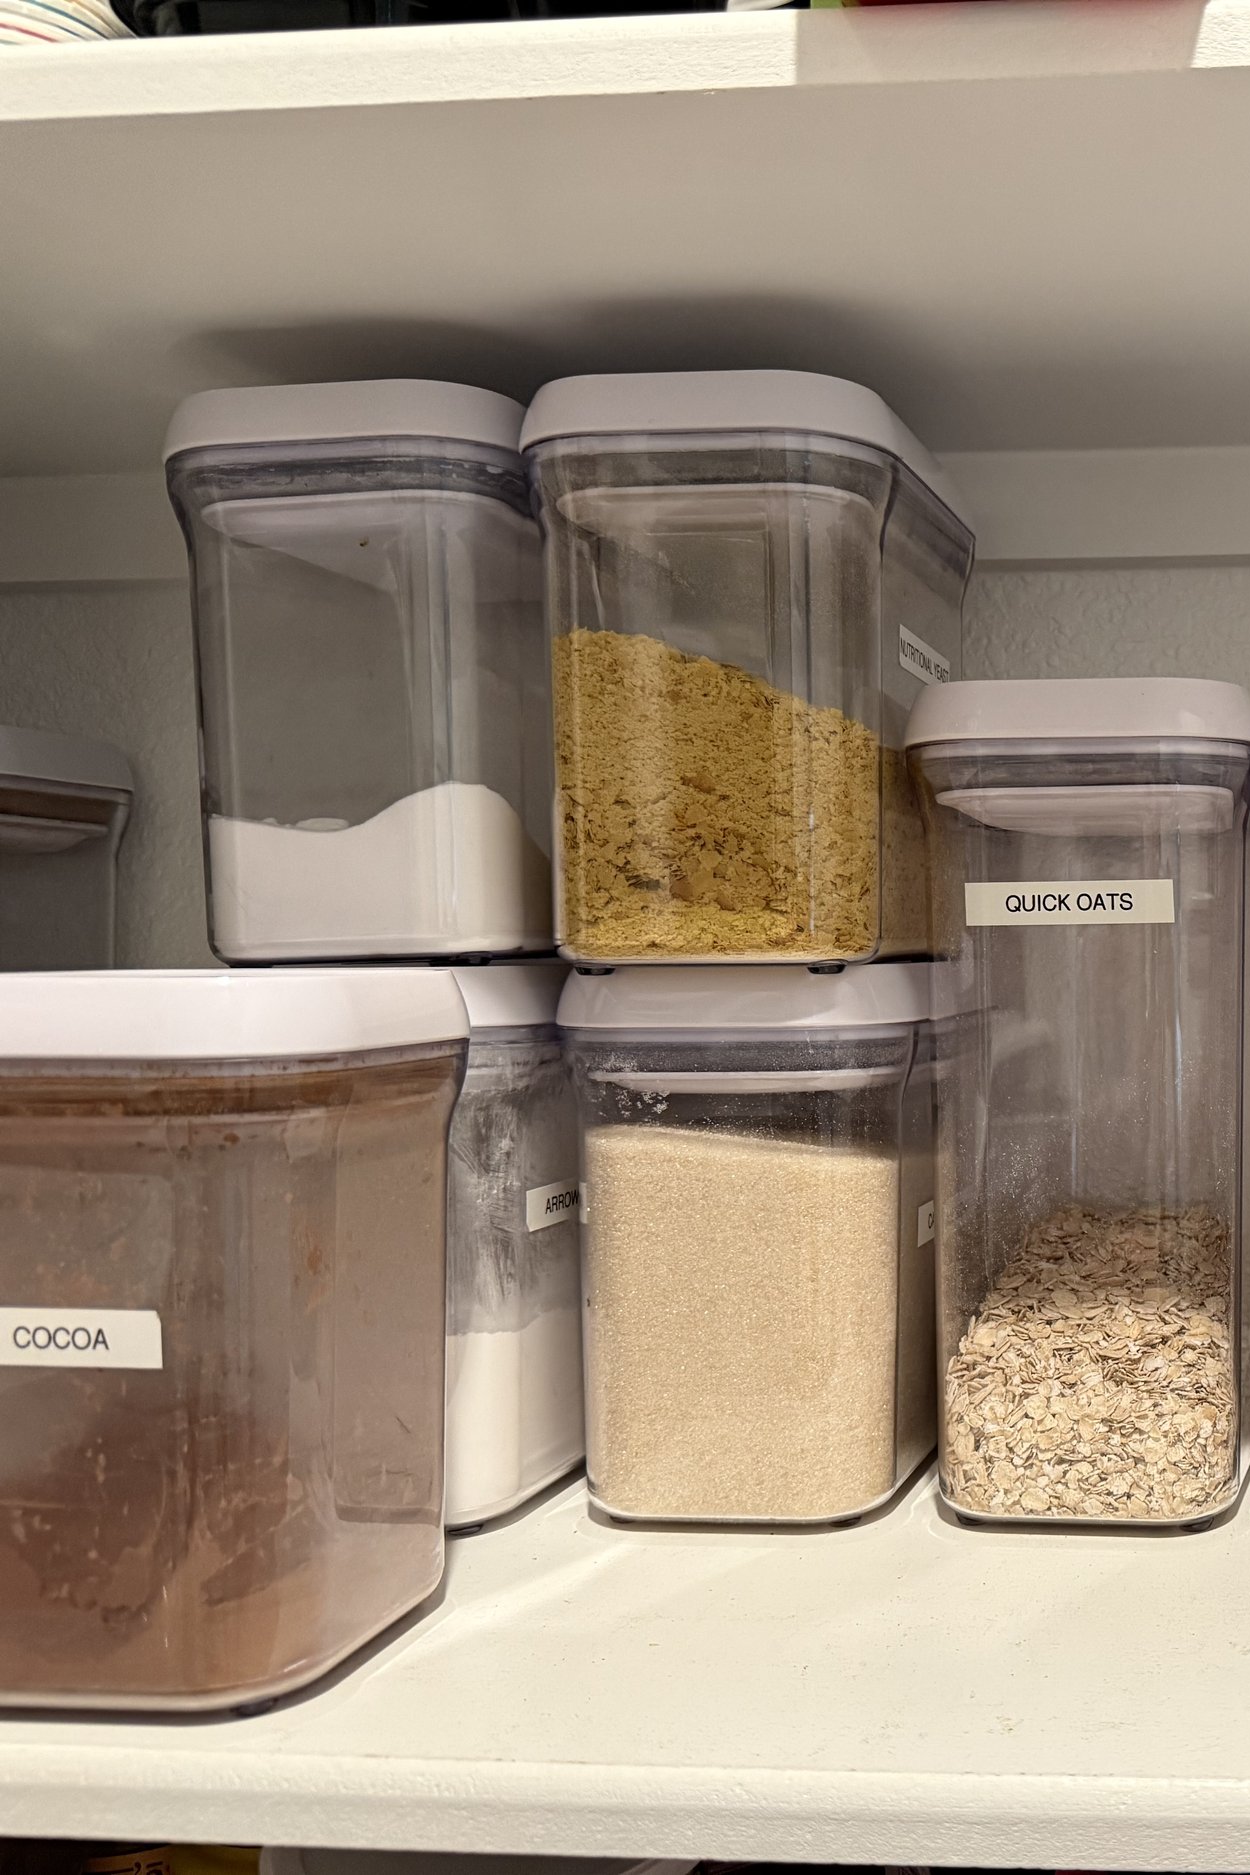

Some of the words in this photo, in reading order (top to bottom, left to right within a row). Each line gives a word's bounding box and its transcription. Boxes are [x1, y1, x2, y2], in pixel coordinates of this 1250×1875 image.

[1005, 894, 1071, 912] QUICK
[1076, 892, 1133, 911] OATS
[13, 1326, 109, 1350] COCOA
